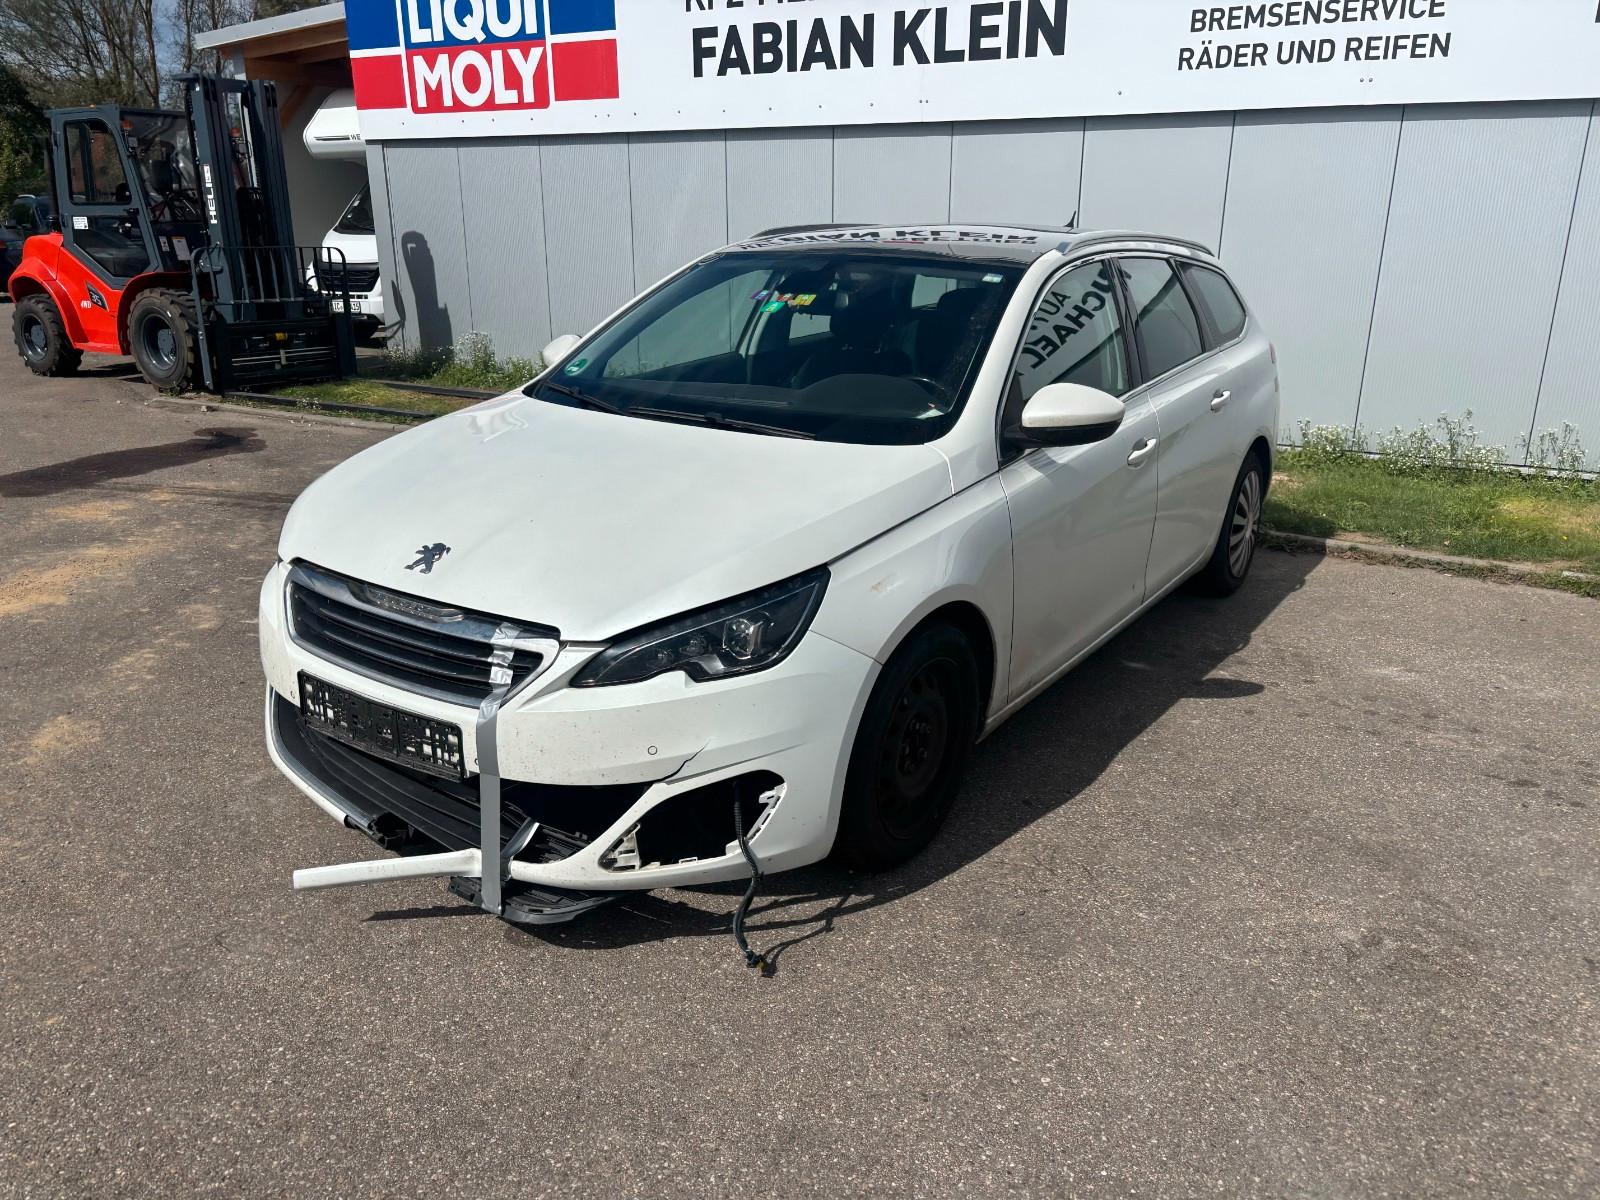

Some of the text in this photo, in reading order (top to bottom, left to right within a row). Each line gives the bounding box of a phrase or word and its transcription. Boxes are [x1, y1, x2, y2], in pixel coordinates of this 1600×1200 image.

[408, 0, 537, 43] LIQUI
[1190, 0, 1446, 33] BREMSENSERVICE
[692, 0, 1068, 78] FABIAN KLEIN
[1177, 32, 1452, 71] RÄDER UND REIFEN
[412, 46, 544, 108] MOLY
